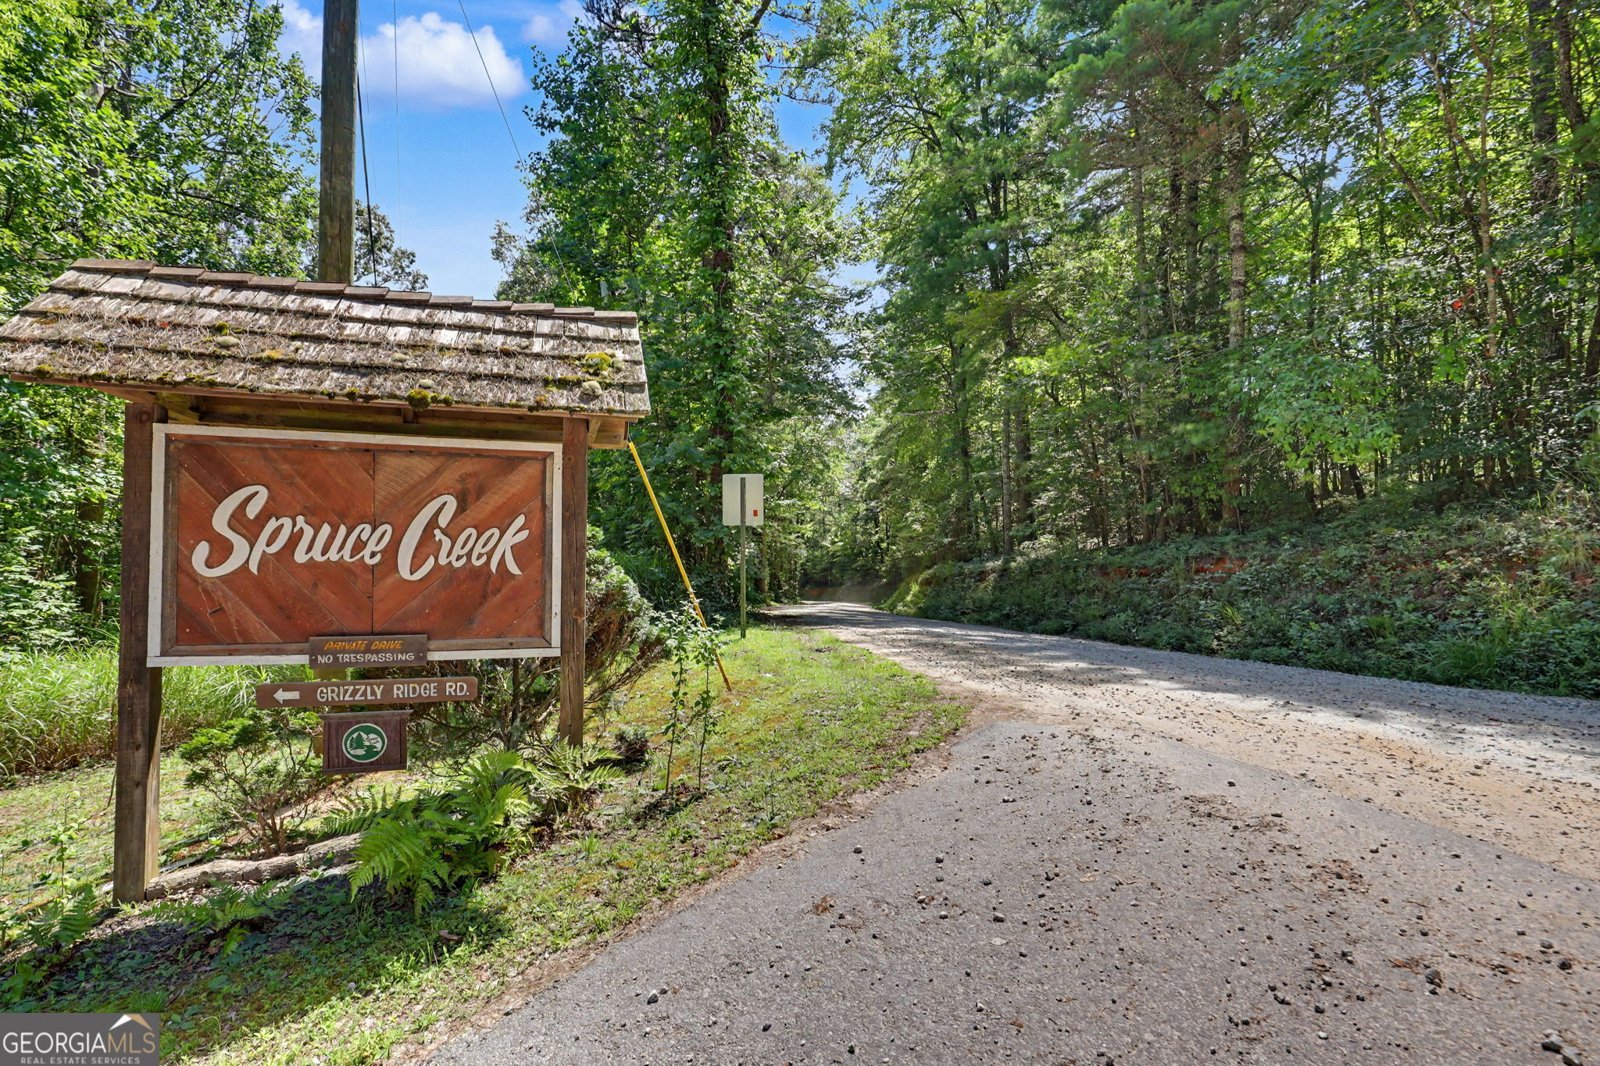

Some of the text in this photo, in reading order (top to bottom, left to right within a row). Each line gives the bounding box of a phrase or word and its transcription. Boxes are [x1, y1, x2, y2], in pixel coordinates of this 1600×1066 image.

[191, 484, 530, 581] Spruce Creek
[323, 640, 404, 651] PRIVATE DRIVE
[317, 652, 415, 664] NO TRESPASSING
[317, 681, 470, 702] GRIZZLY RIDGE RD.
